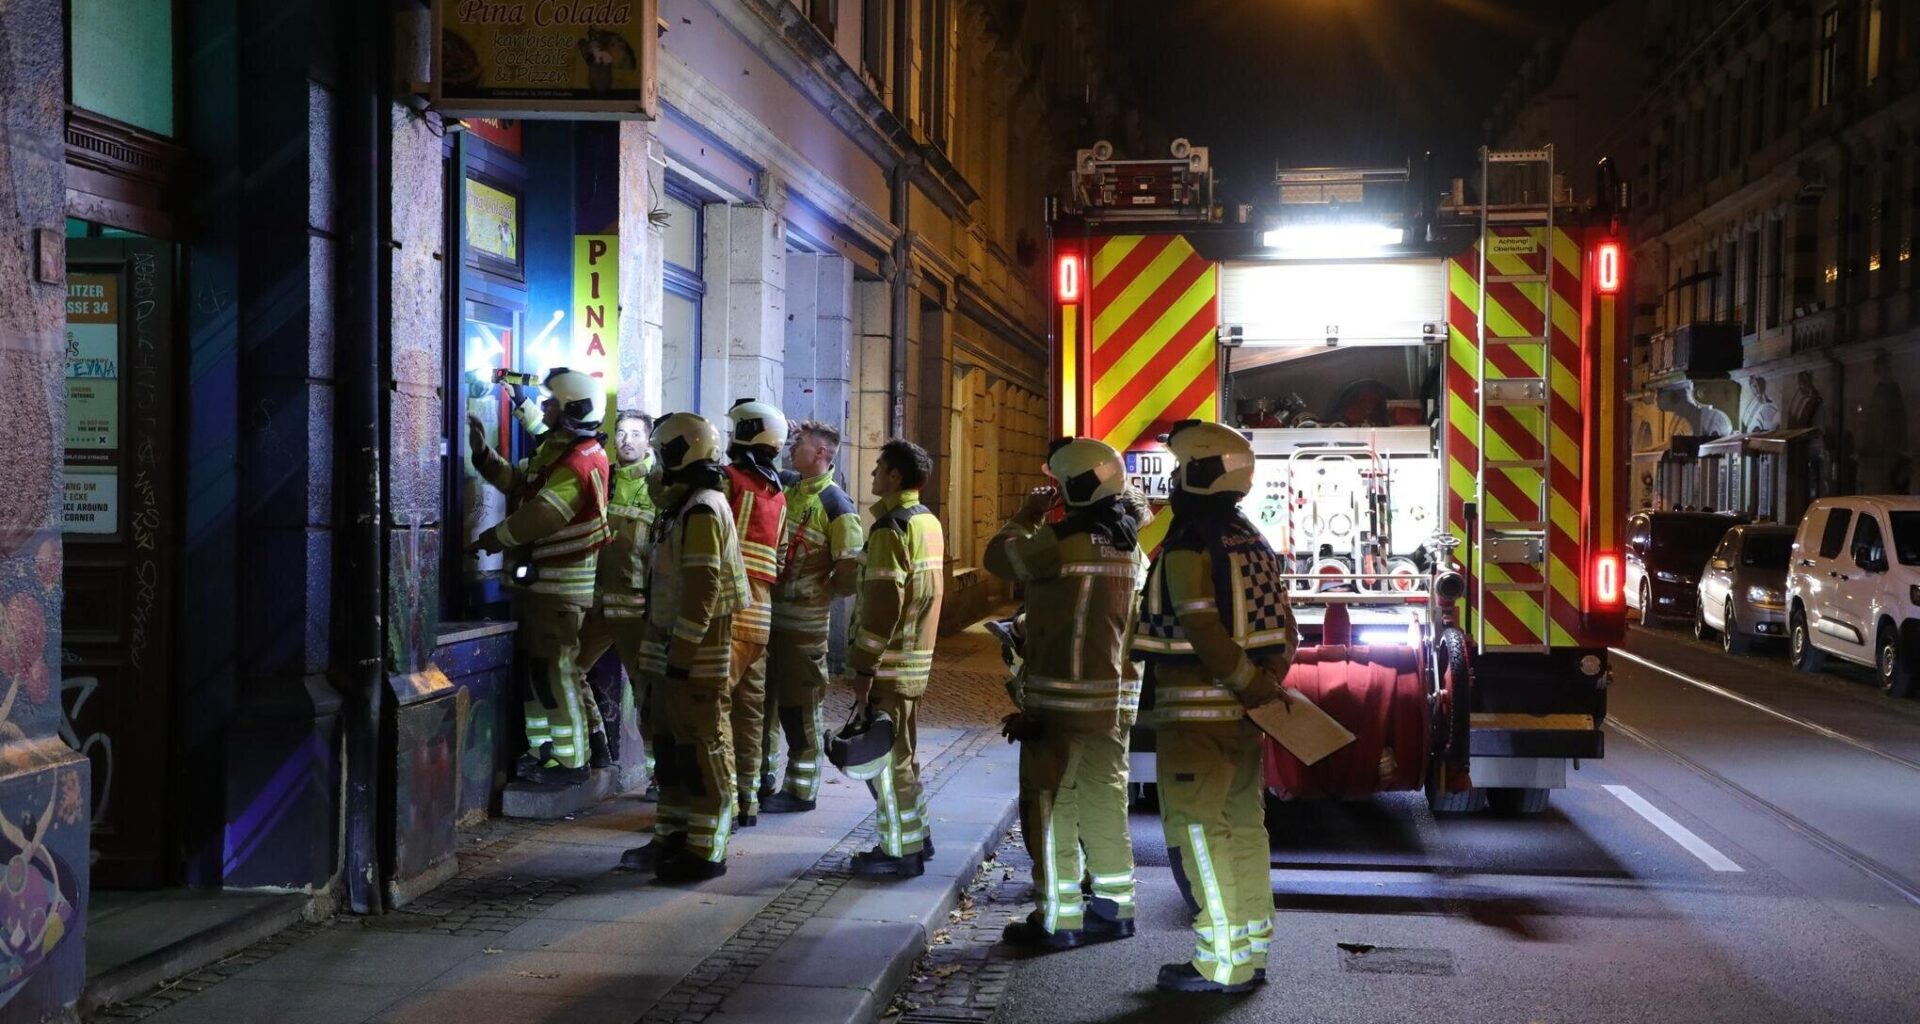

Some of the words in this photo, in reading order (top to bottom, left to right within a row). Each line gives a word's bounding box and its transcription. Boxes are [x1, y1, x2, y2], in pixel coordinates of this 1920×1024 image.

[534, 0, 632, 27] Colada
[494, 29, 575, 48] karibische
[496, 48, 568, 65] Cocktails
[516, 65, 568, 82] Pizzen
[586, 239, 607, 356] PINA
[65, 302, 89, 314] SSE
[93, 302, 108, 314] 34
[1141, 456, 1162, 475] DD
[70, 493, 88, 501] ECKE
